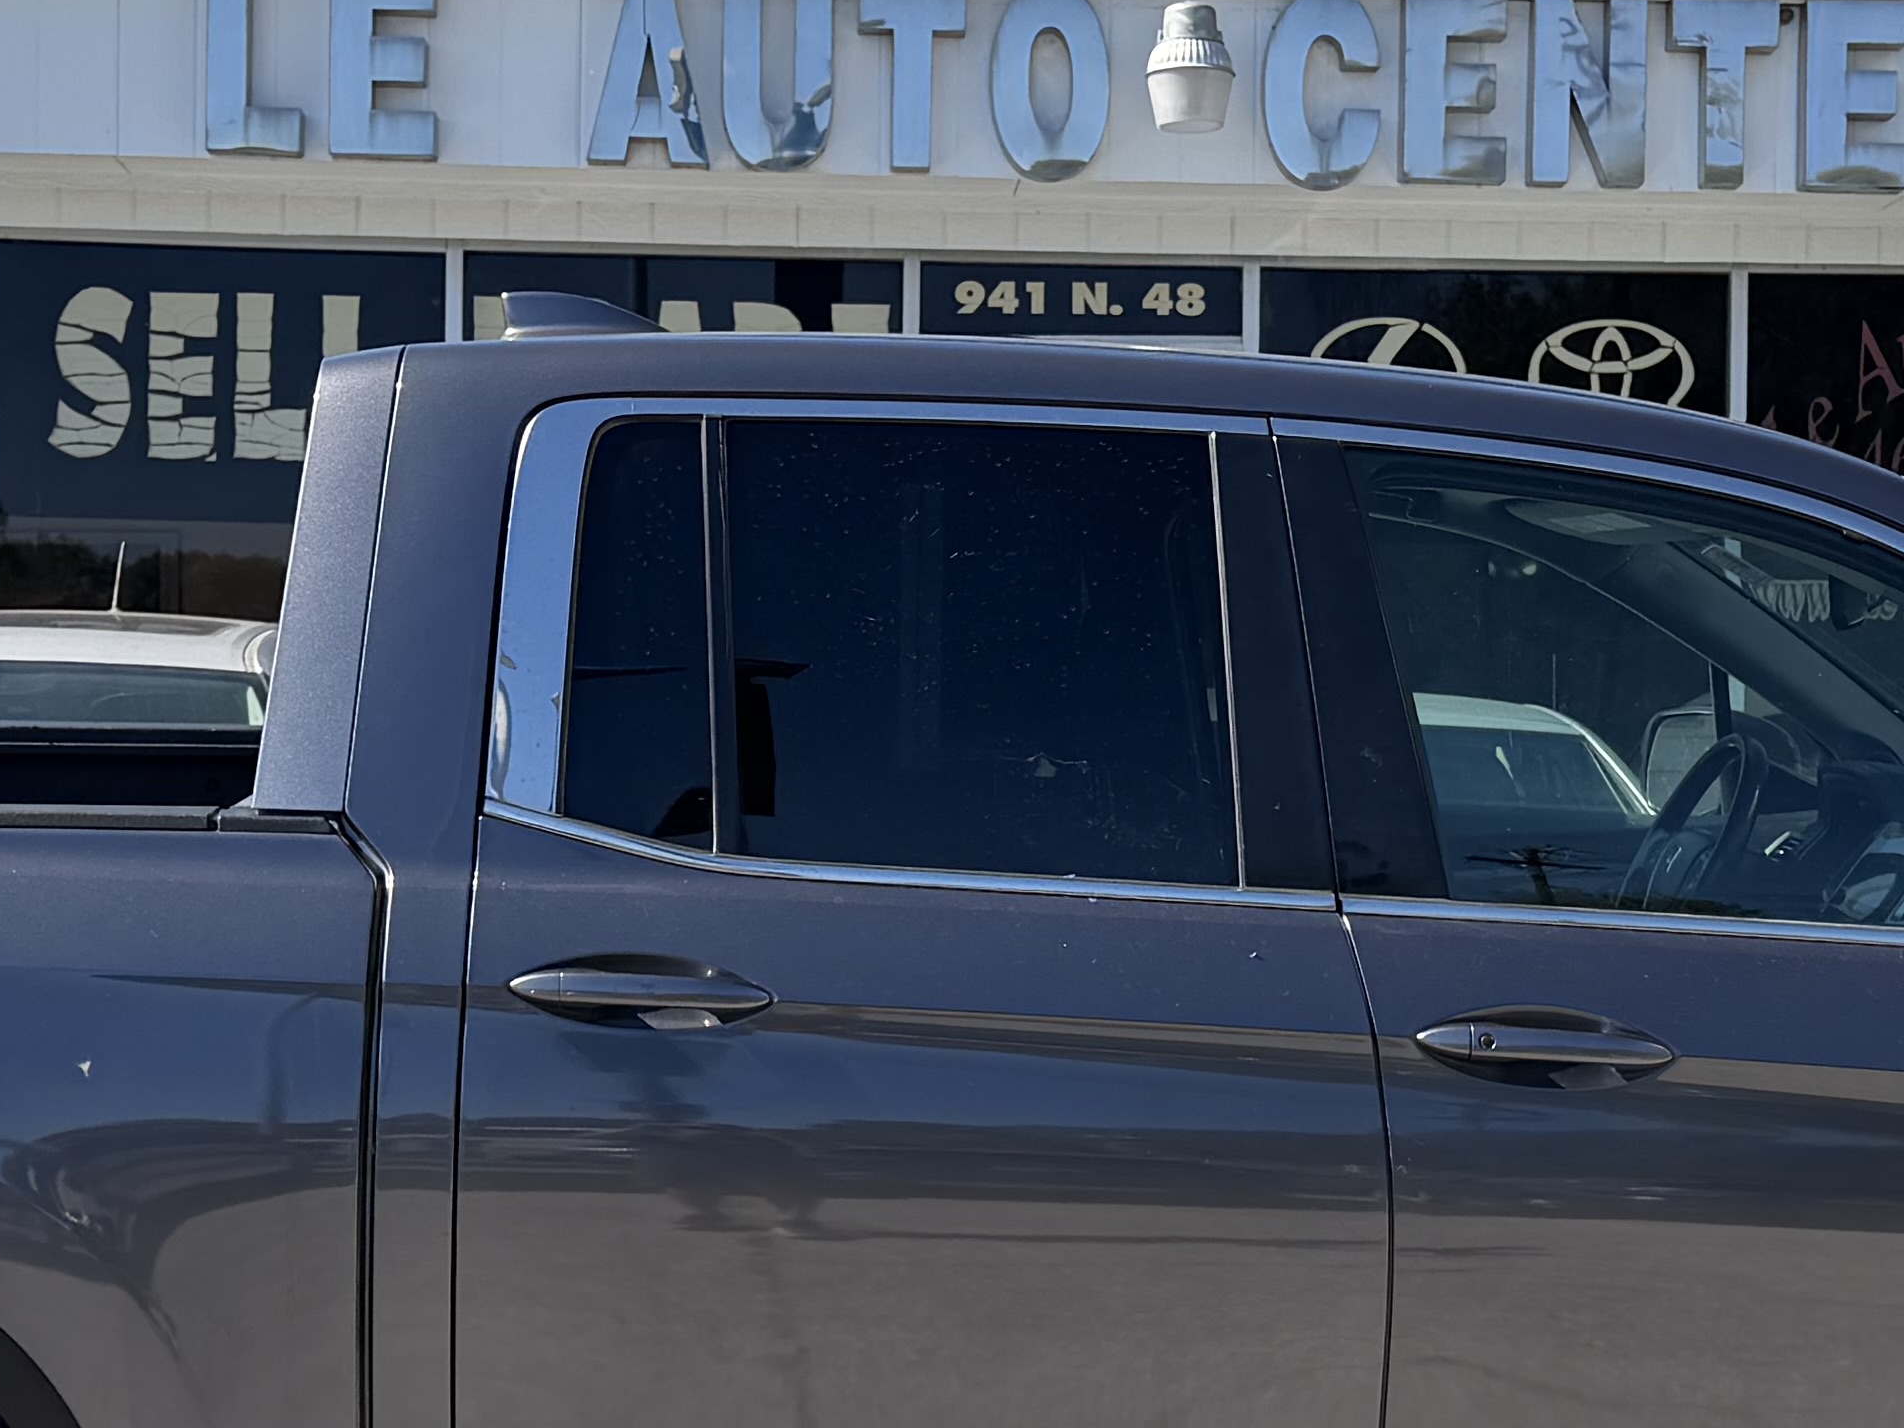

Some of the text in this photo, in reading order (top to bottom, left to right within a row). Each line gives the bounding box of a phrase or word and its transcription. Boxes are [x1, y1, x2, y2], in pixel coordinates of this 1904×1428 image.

[954, 280, 1206, 317] 941 N. 48
